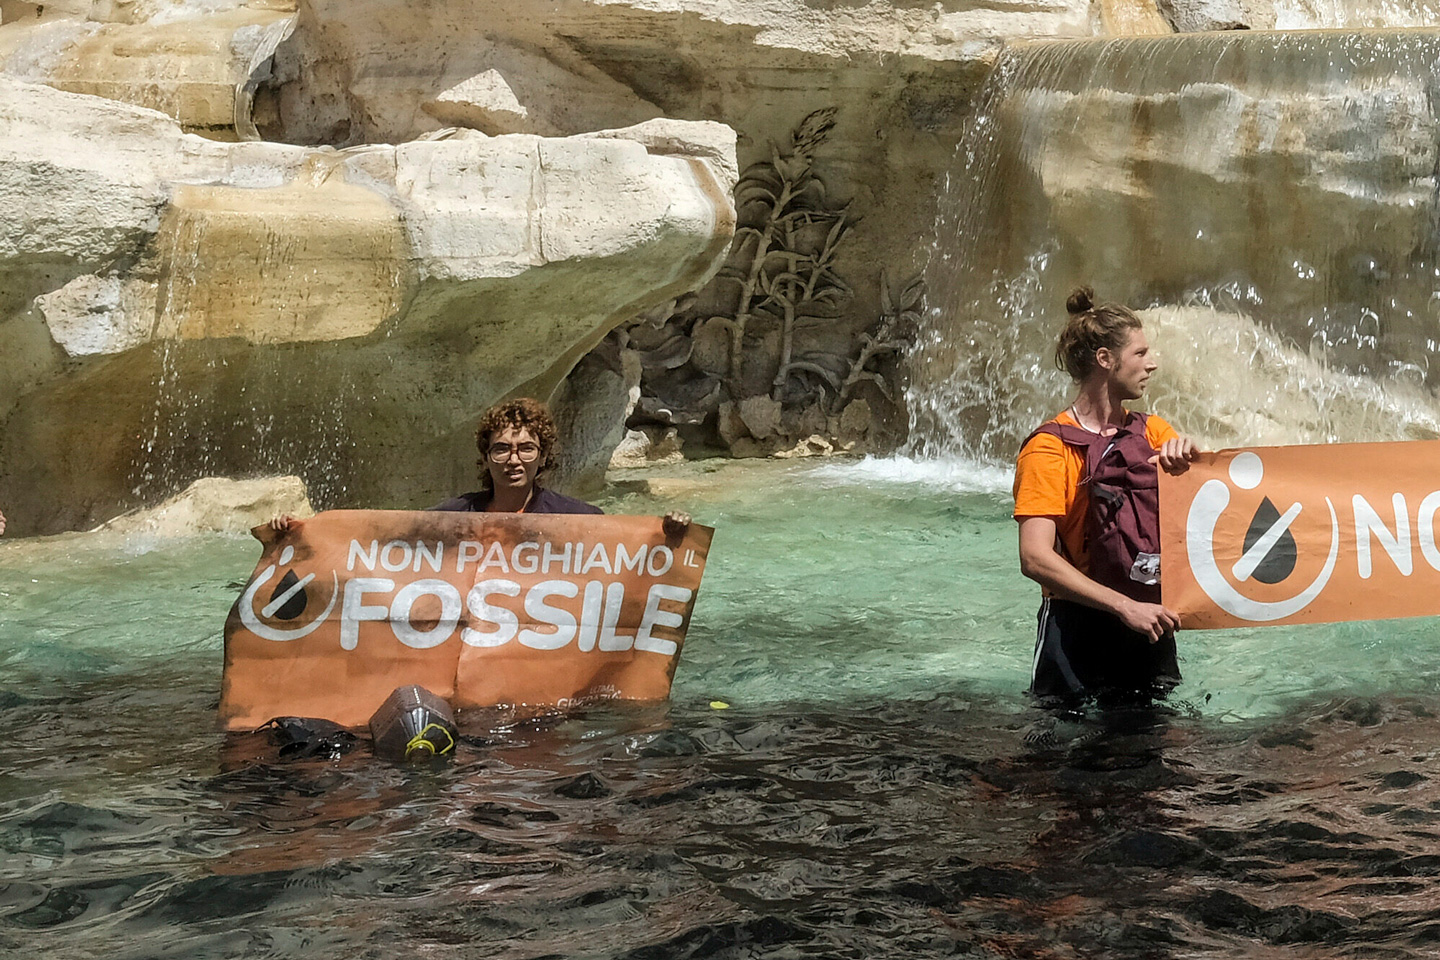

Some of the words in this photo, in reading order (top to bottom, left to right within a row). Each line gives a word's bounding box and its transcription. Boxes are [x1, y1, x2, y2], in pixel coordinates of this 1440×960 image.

[347, 539, 444, 573] NON
[456, 541, 673, 577] PAGHIAMO
[683, 549, 699, 568] IL
[340, 577, 692, 656] FOSSILE
